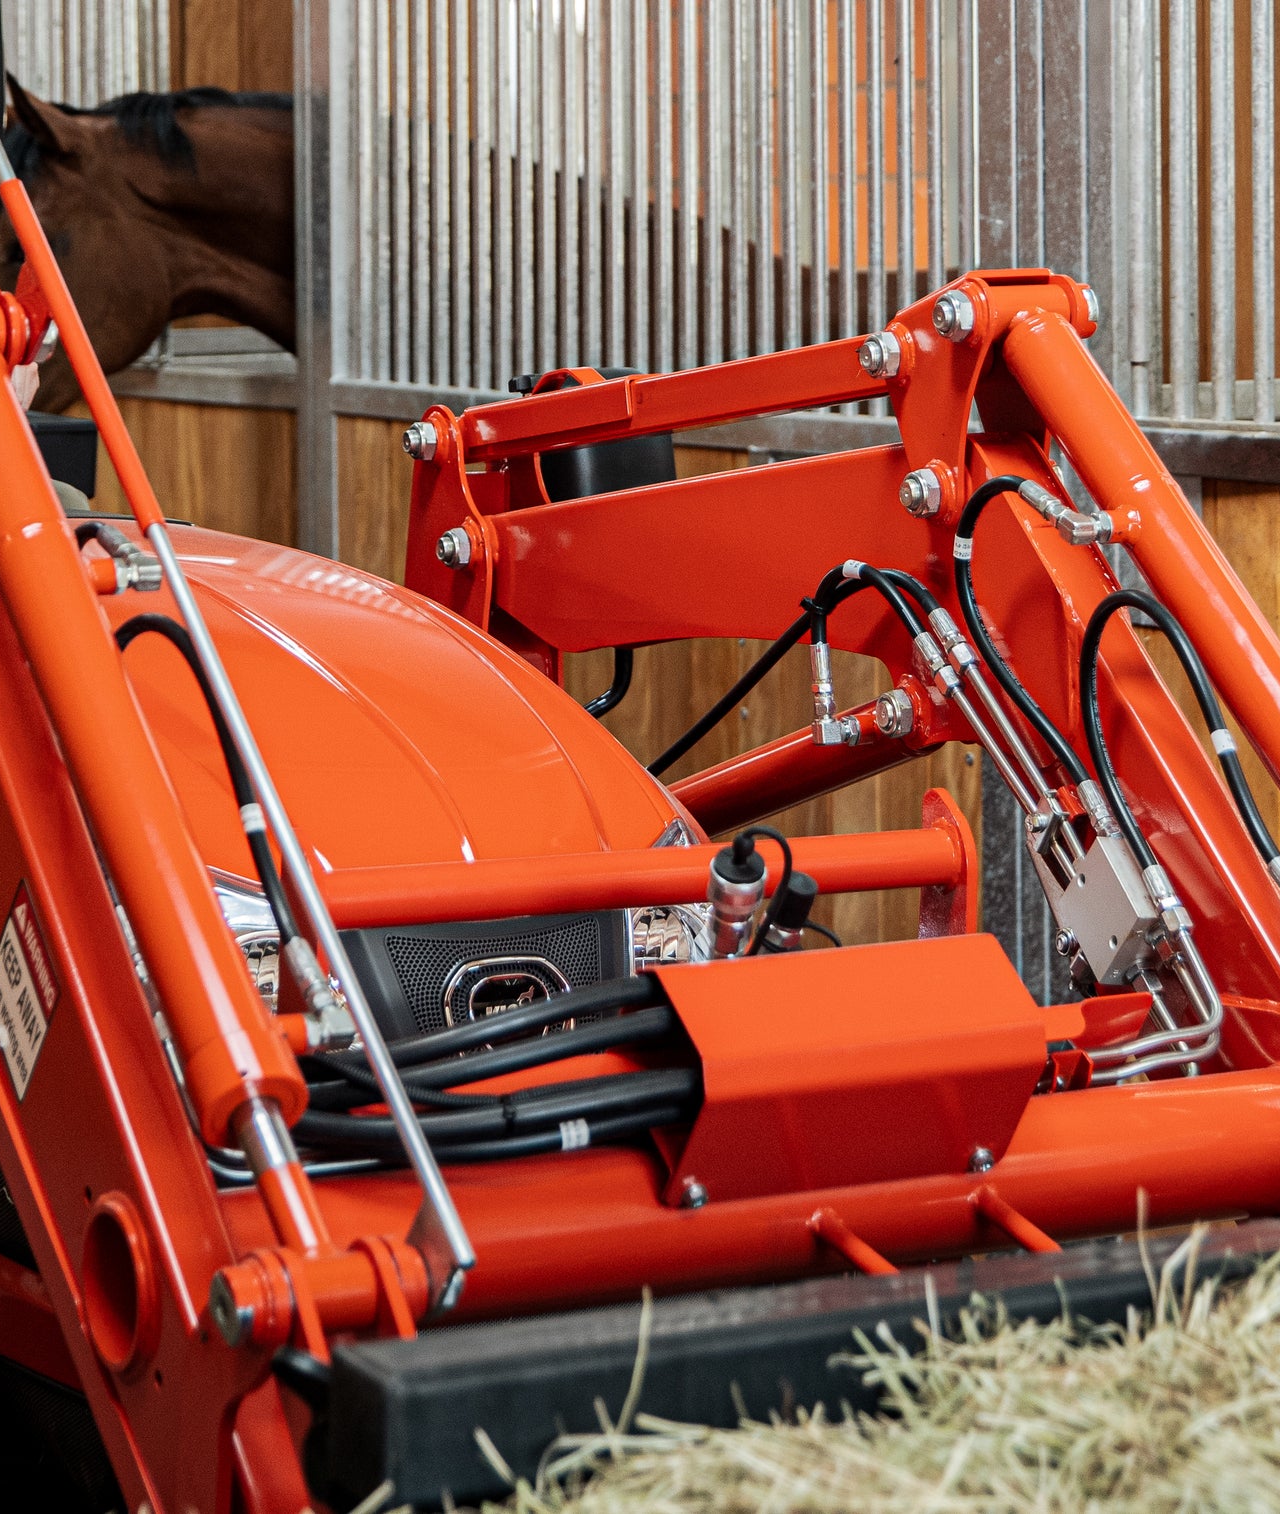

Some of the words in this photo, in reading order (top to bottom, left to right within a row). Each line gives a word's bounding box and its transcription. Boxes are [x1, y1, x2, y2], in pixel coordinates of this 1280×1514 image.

[0, 932, 22, 989] KEEP
[16, 986, 41, 1050] AWAY
[24, 919, 56, 1009] WARNING
[1, 1002, 19, 1056] working
[16, 1051, 28, 1083] area
